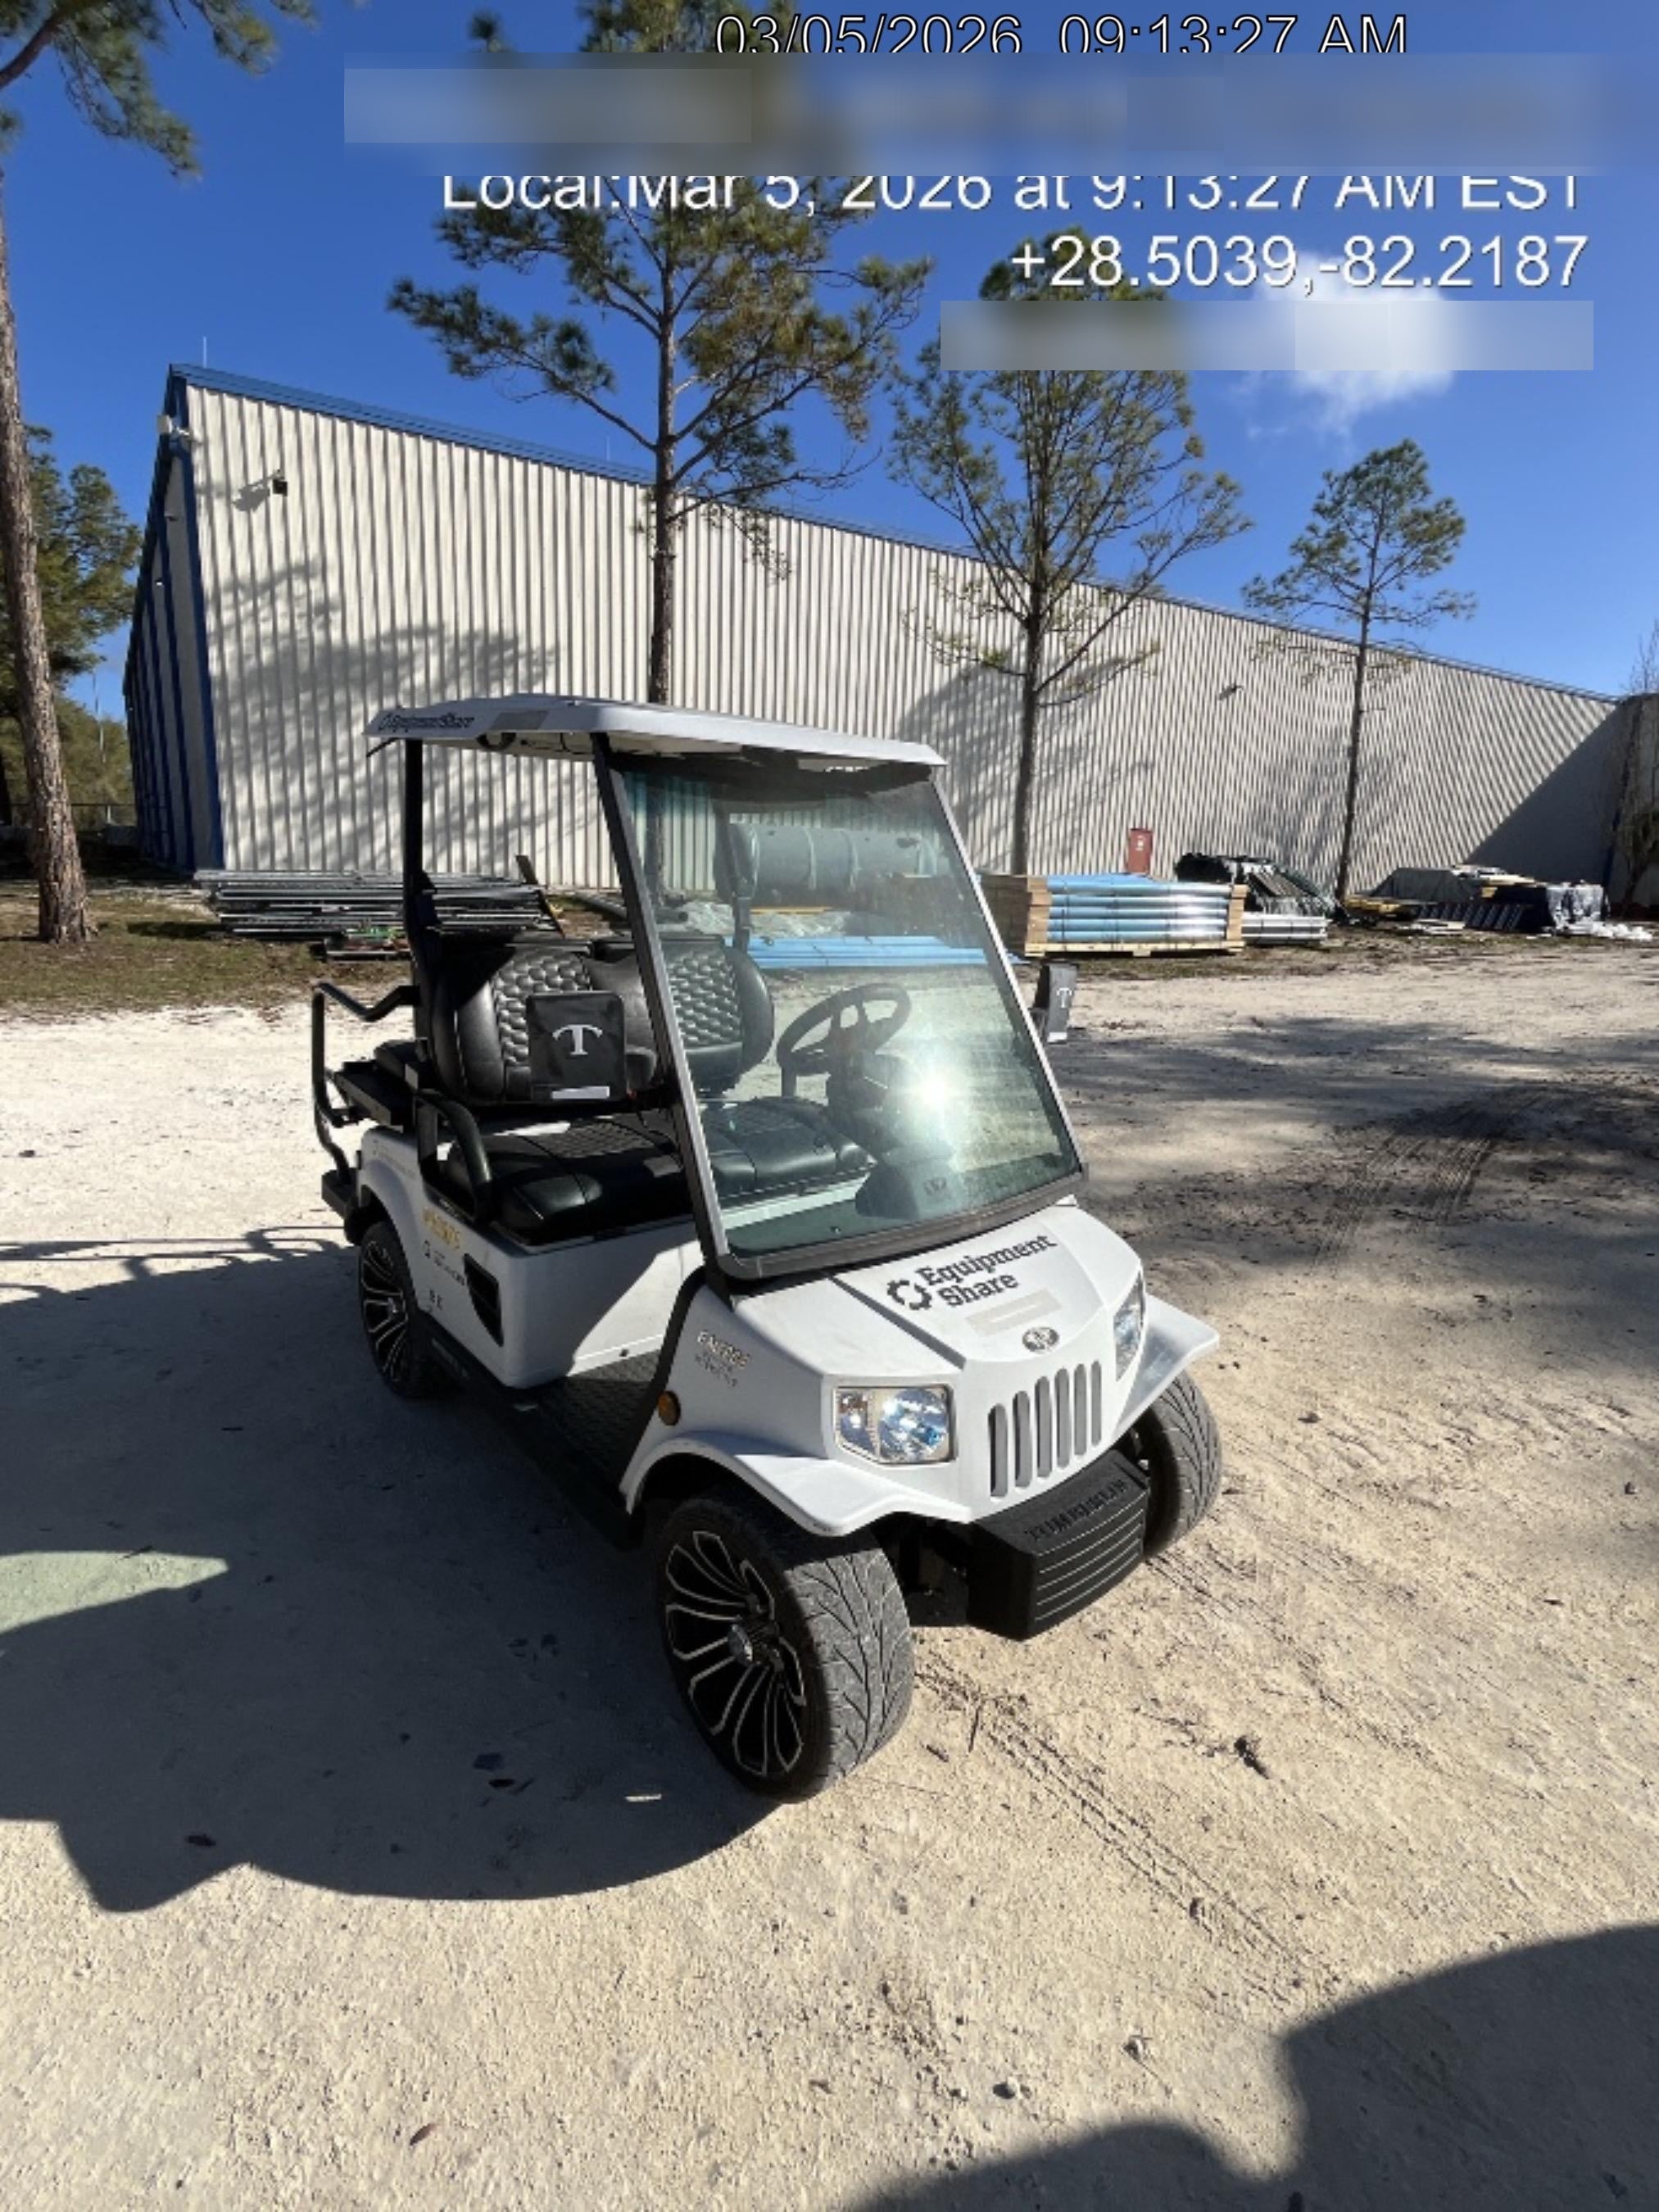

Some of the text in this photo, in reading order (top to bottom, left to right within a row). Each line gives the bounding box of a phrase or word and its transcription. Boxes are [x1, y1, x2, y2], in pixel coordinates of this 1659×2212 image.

[552, 1024, 603, 1055] T
[915, 1235, 1057, 1285] Equipment
[937, 1275, 1019, 1308] Share
